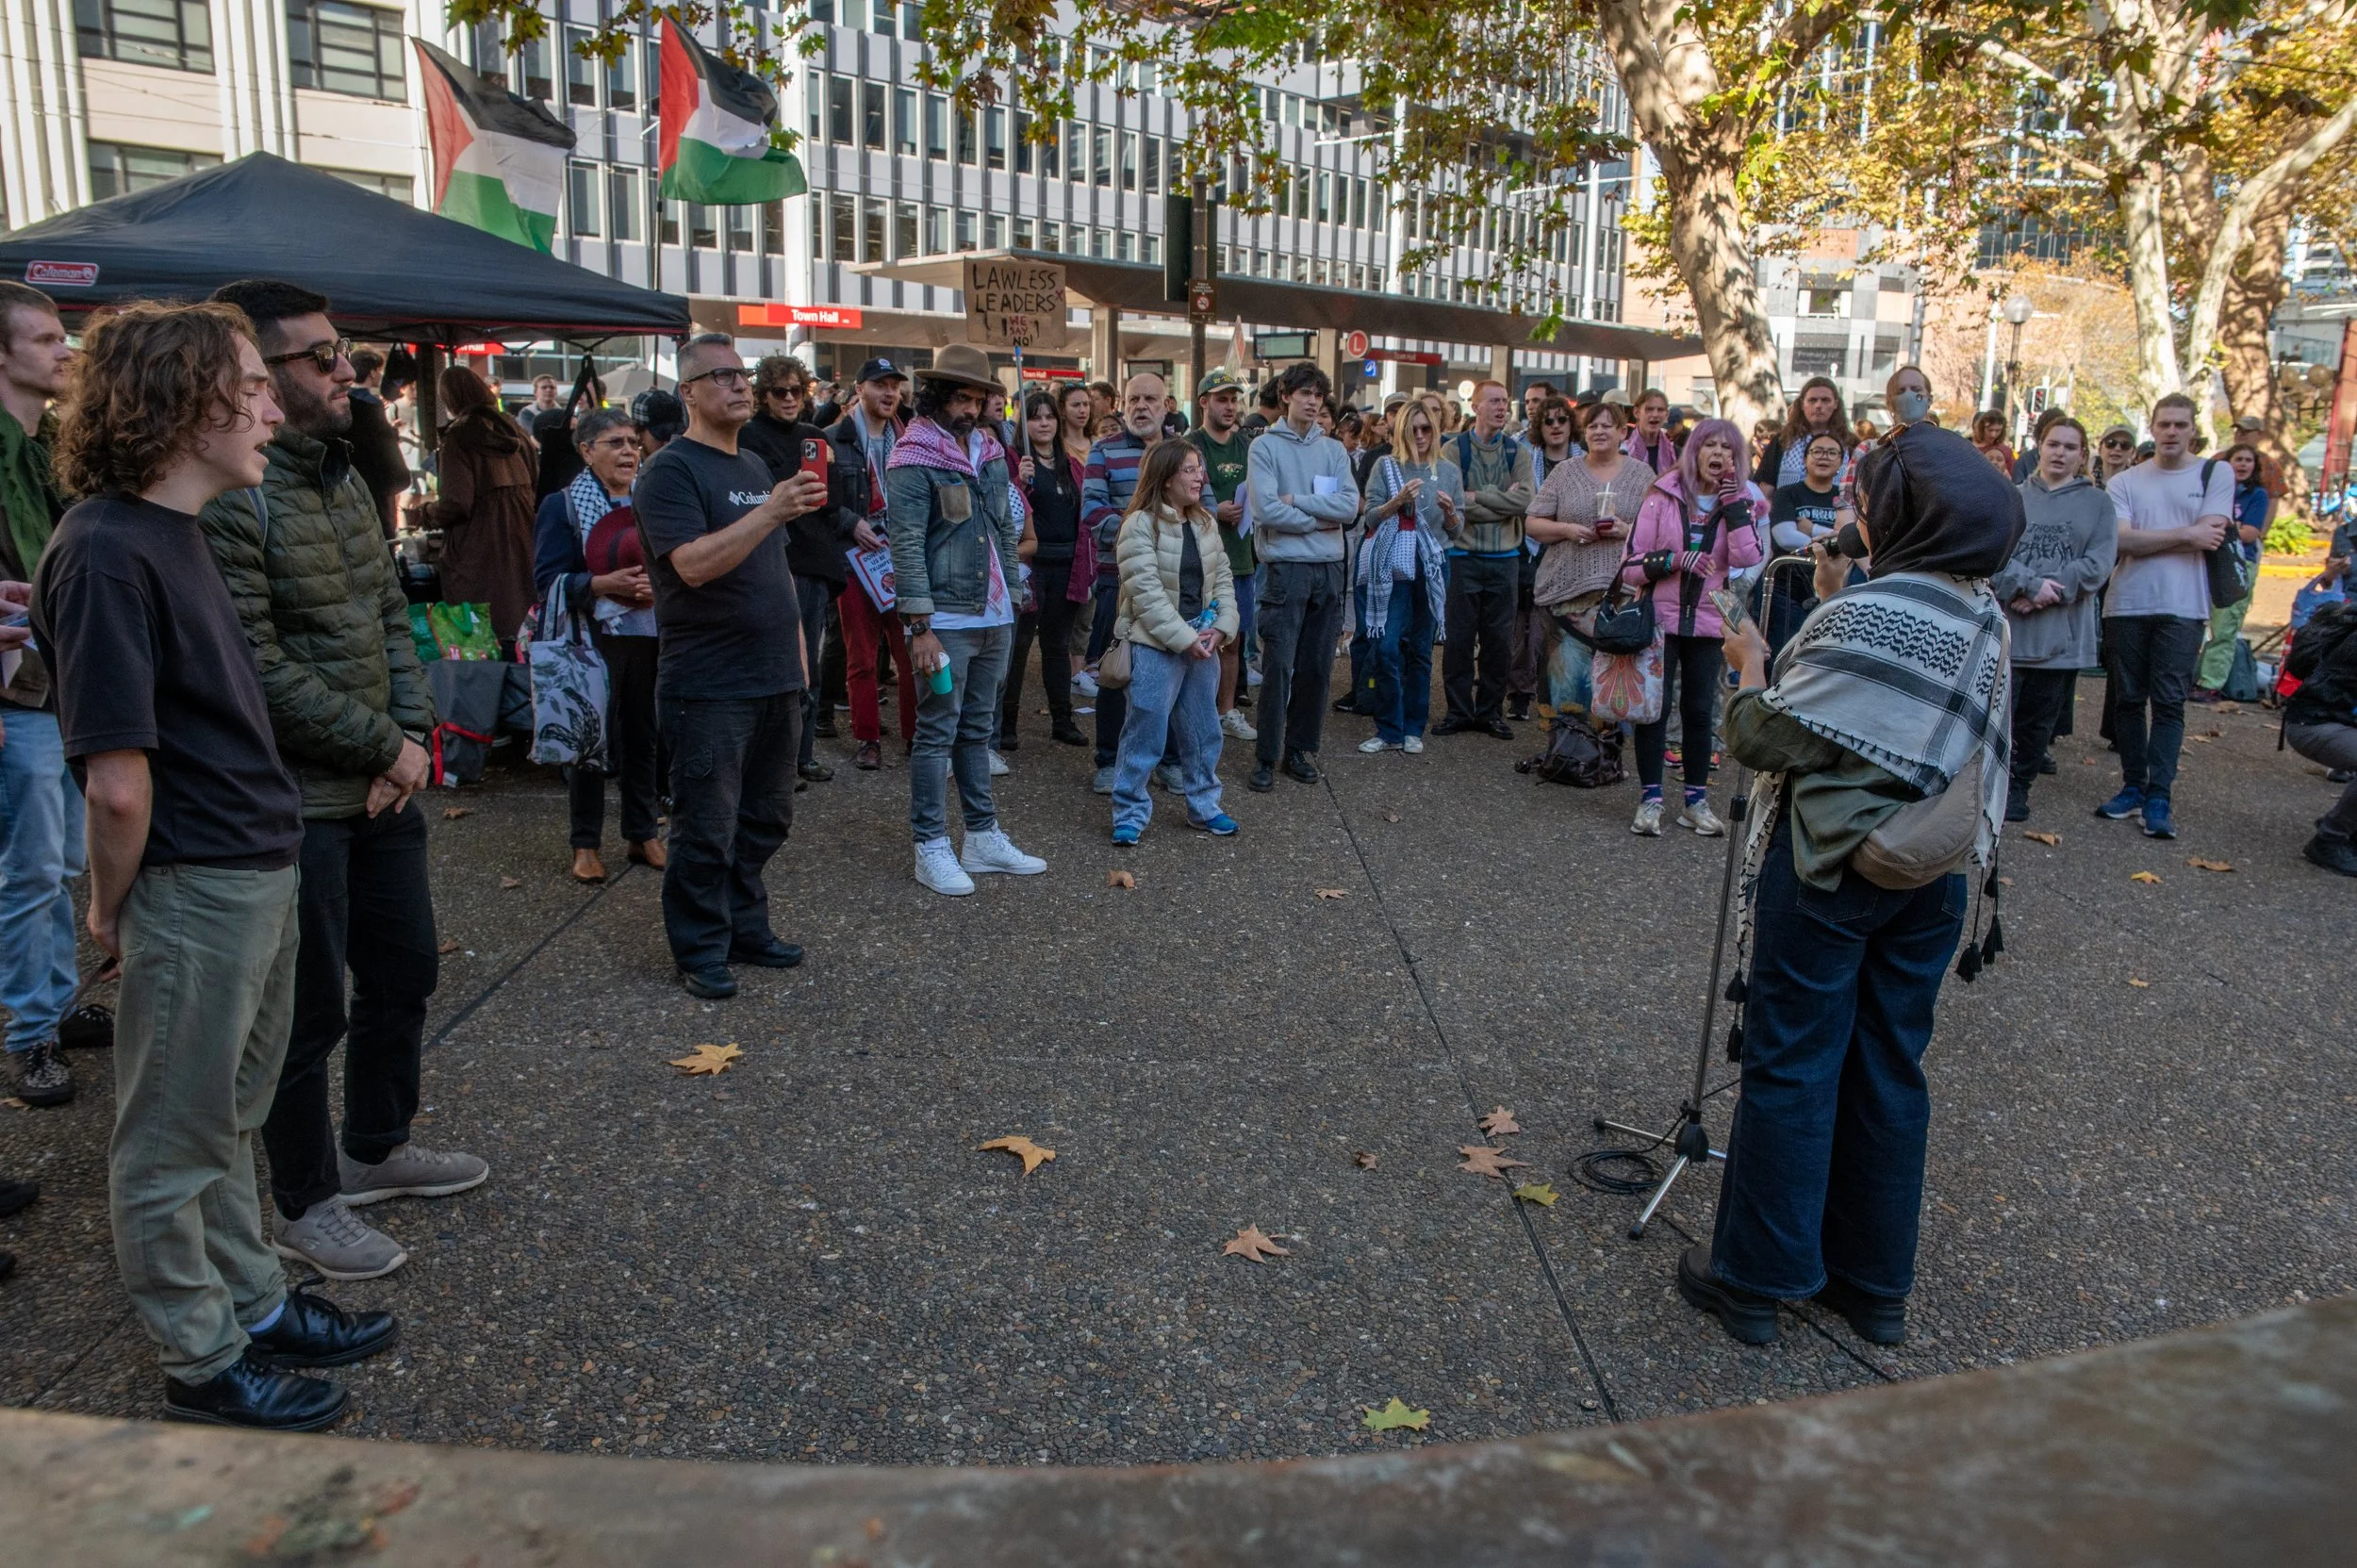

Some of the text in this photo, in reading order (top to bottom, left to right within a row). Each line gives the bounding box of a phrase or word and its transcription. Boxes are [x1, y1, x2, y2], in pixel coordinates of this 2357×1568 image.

[33, 264, 82, 278] Coleman
[973, 264, 1056, 290] LAWLESS
[976, 293, 1056, 313] LEADERS
[791, 309, 839, 322] Town Hall
[1010, 316, 1027, 325] WE
[1010, 326, 1028, 336] SAY
[1014, 335, 1033, 347] NO!
[1354, 337, 1361, 352] L
[738, 490, 770, 504] Columbi
[2012, 540, 2073, 567] DREAM
